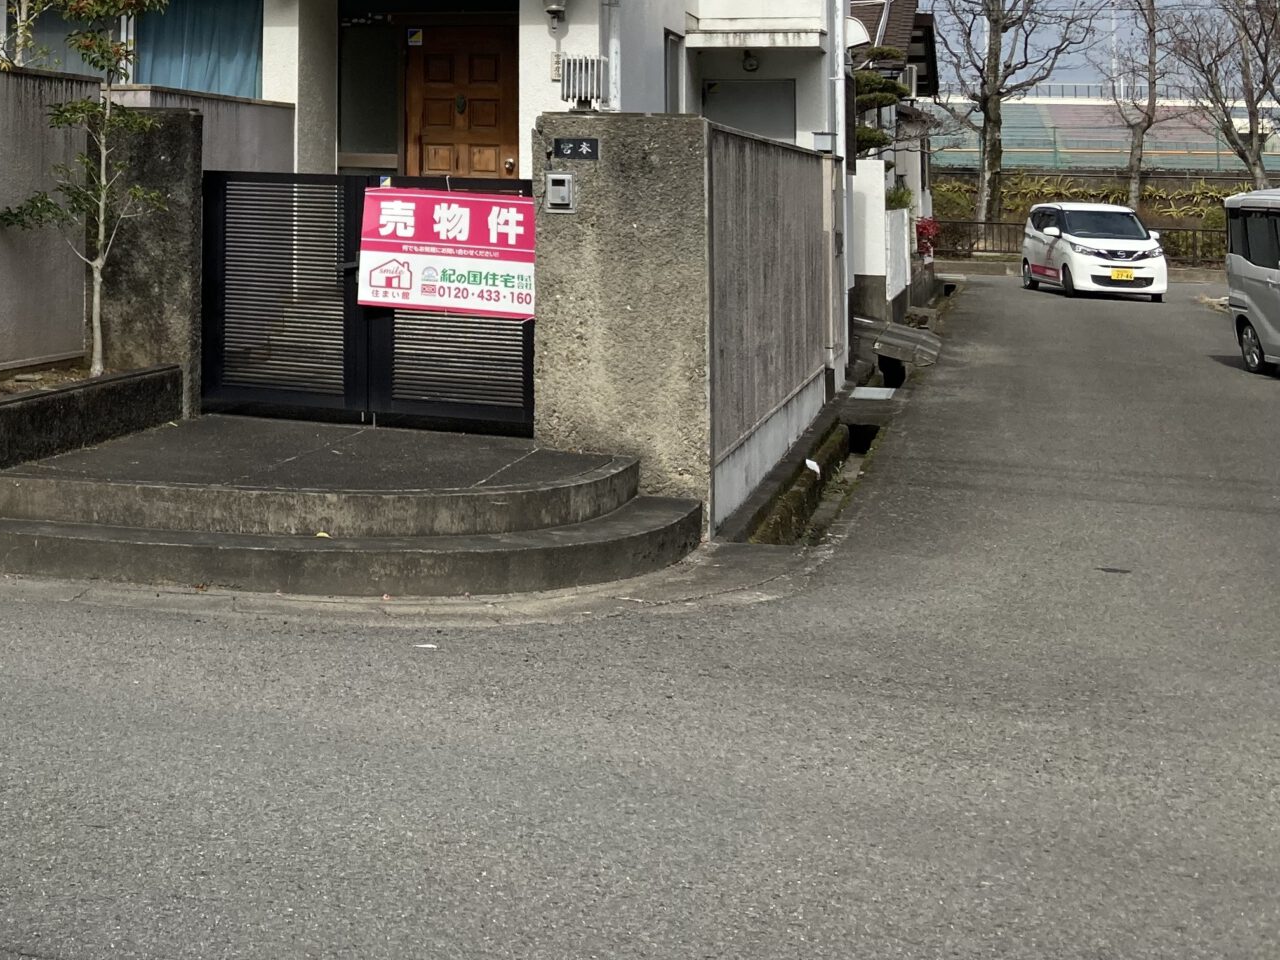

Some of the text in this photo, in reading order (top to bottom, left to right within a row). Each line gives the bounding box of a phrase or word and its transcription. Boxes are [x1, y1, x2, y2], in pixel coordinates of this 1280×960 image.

[379, 200, 524, 245] 売物件
[440, 268, 515, 289] 紀の国住宅
[371, 289, 410, 300] 住まい館
